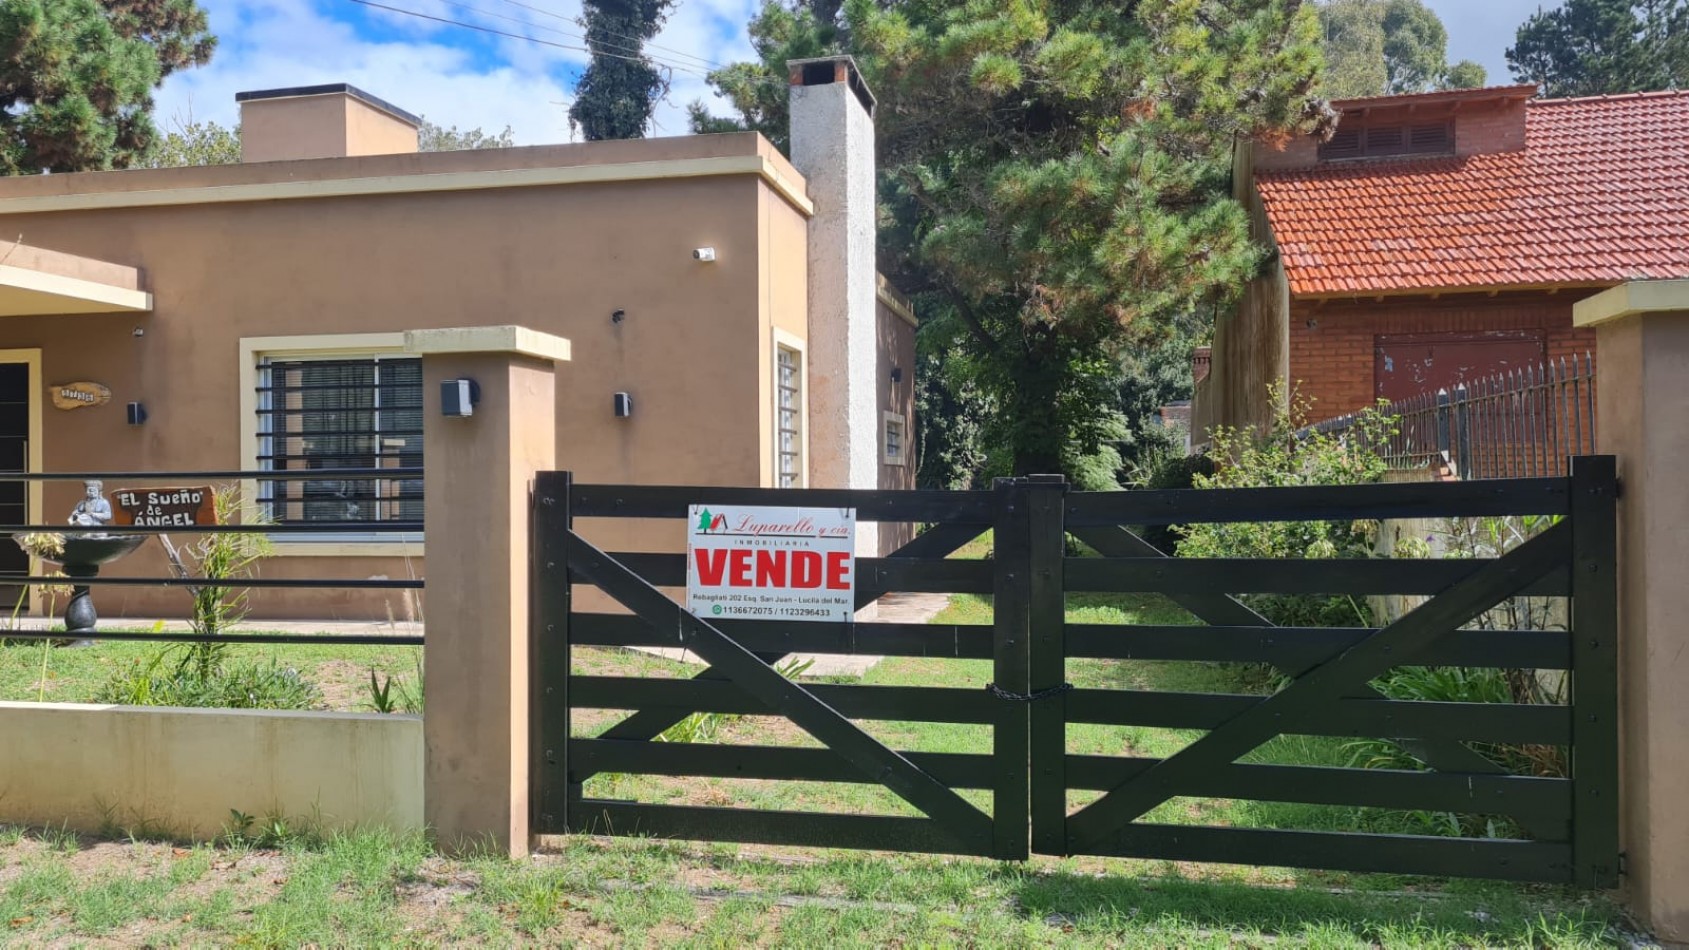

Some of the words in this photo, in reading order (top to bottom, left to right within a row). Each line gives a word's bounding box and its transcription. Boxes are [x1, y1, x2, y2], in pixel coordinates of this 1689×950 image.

[147, 506, 162, 515] de
[134, 512, 194, 526] ÁNGEL
[733, 513, 814, 537] Luparello
[734, 539, 810, 547] INMOBILIARIA
[694, 548, 850, 590] VENDE
